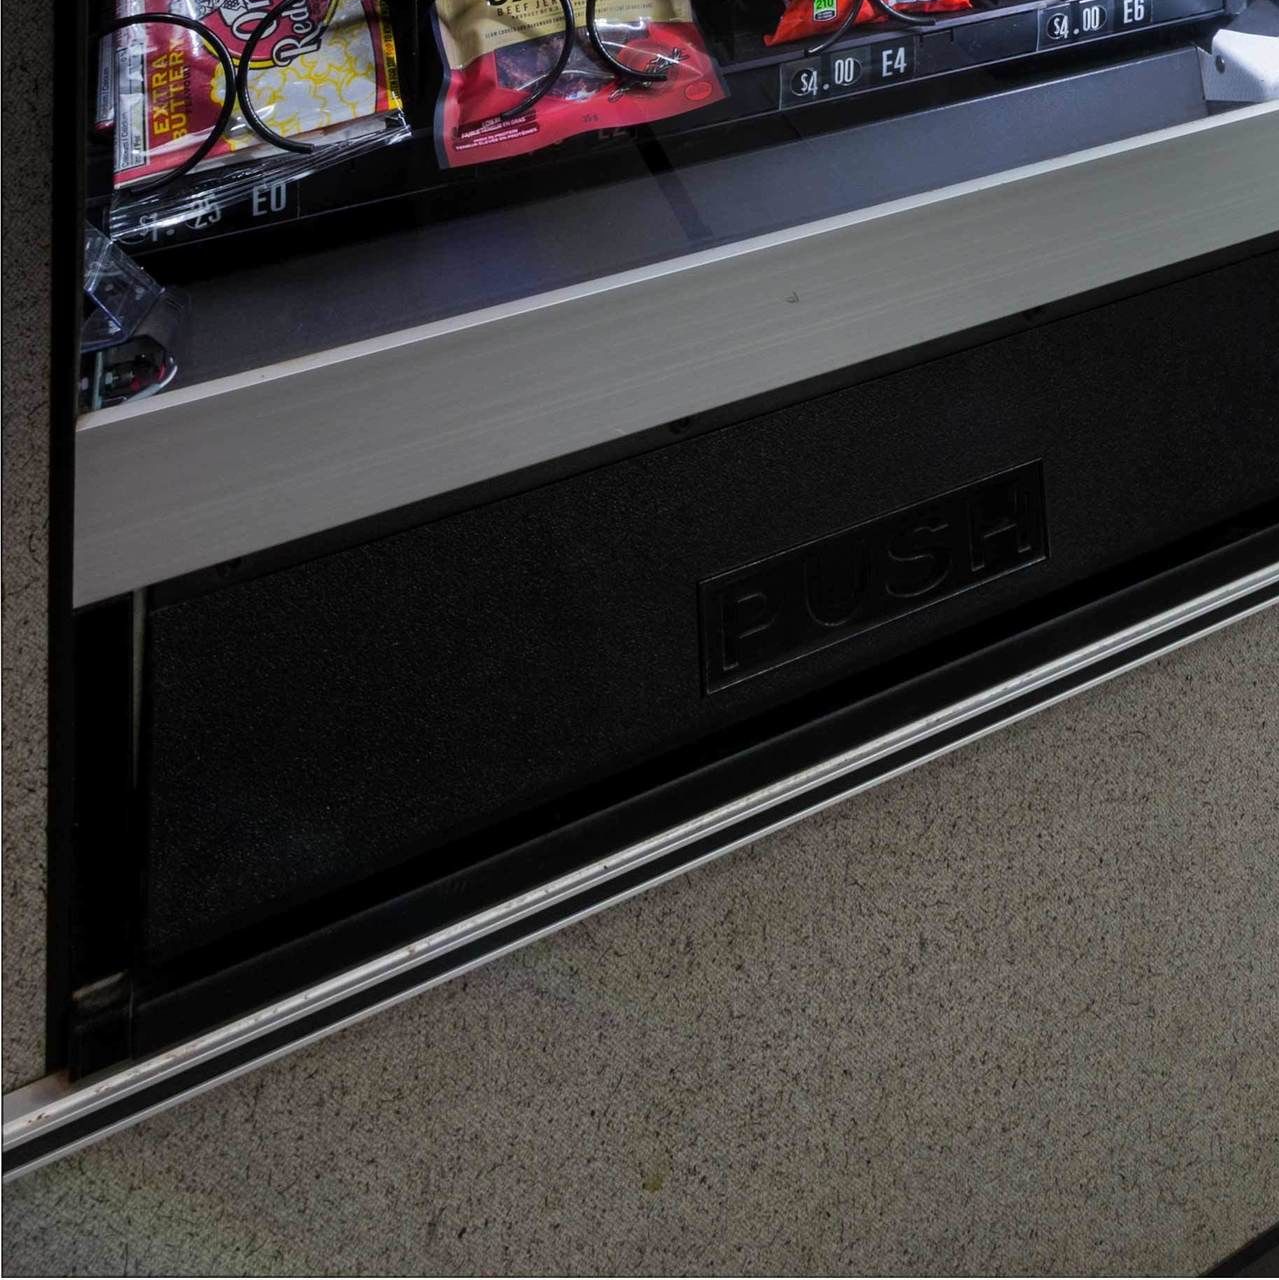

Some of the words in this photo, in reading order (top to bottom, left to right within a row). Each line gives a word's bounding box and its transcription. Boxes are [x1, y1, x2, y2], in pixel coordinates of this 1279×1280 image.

[496, 3, 529, 18] BEEF
[1053, 6, 1100, 39] $4.00
[800, 55, 855, 97] $4.00
[882, 47, 907, 78] E4
[152, 54, 170, 136] EXTRA
[170, 37, 190, 142] BUTTERY
[252, 181, 287, 217] E0
[720, 485, 1035, 672] PUSH
